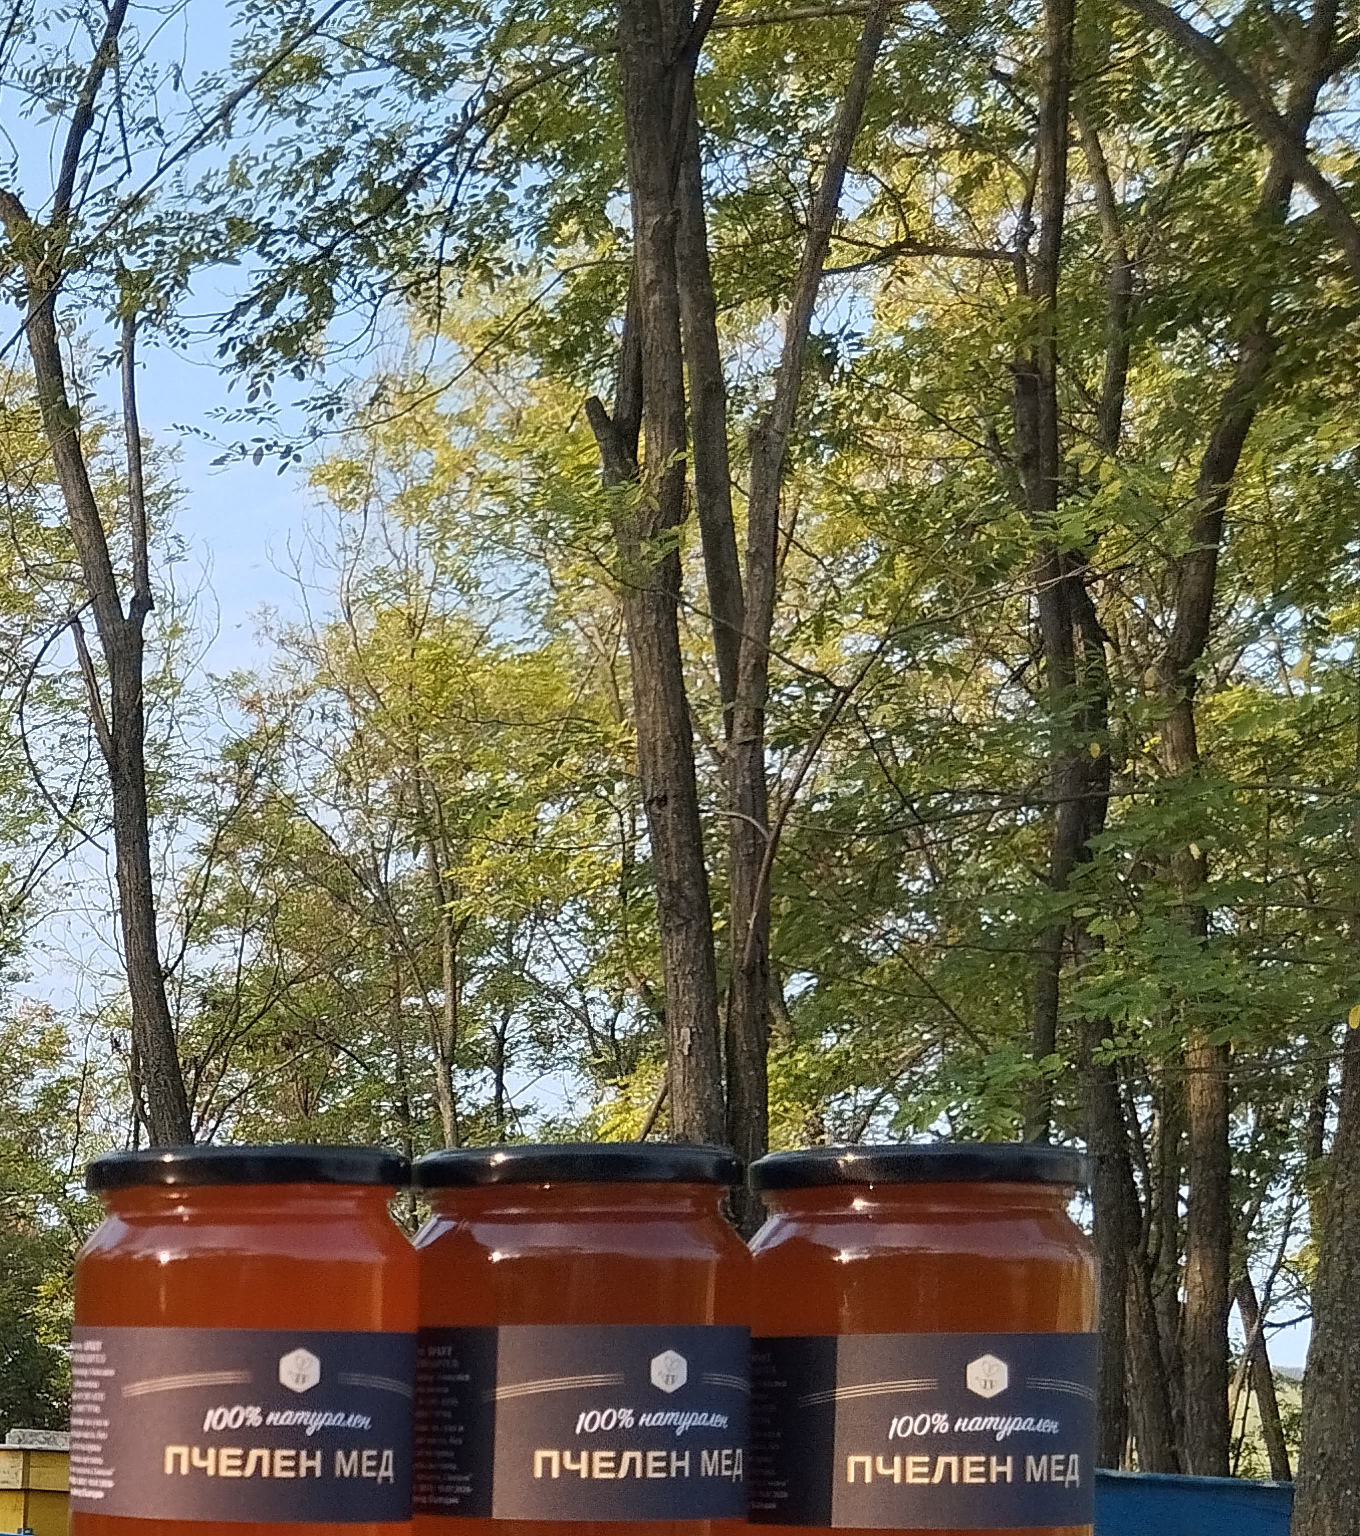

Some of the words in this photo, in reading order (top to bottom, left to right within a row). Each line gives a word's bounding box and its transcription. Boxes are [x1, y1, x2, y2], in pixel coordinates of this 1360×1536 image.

[203, 1405, 261, 1432] 100%
[265, 1409, 372, 1436] натурален
[575, 1408, 635, 1435] 100%
[639, 1412, 728, 1436] натурален
[889, 1414, 949, 1440] 100%
[954, 1415, 1060, 1441] натурален
[165, 1445, 322, 1479] ПЧЕЛЕН
[335, 1449, 394, 1484] МЕД
[534, 1450, 690, 1479] ПЧЕЛЕН
[700, 1449, 743, 1483] МЕД
[847, 1455, 1012, 1484] ПЧЕЛЕН
[1026, 1454, 1079, 1489] МЕД
